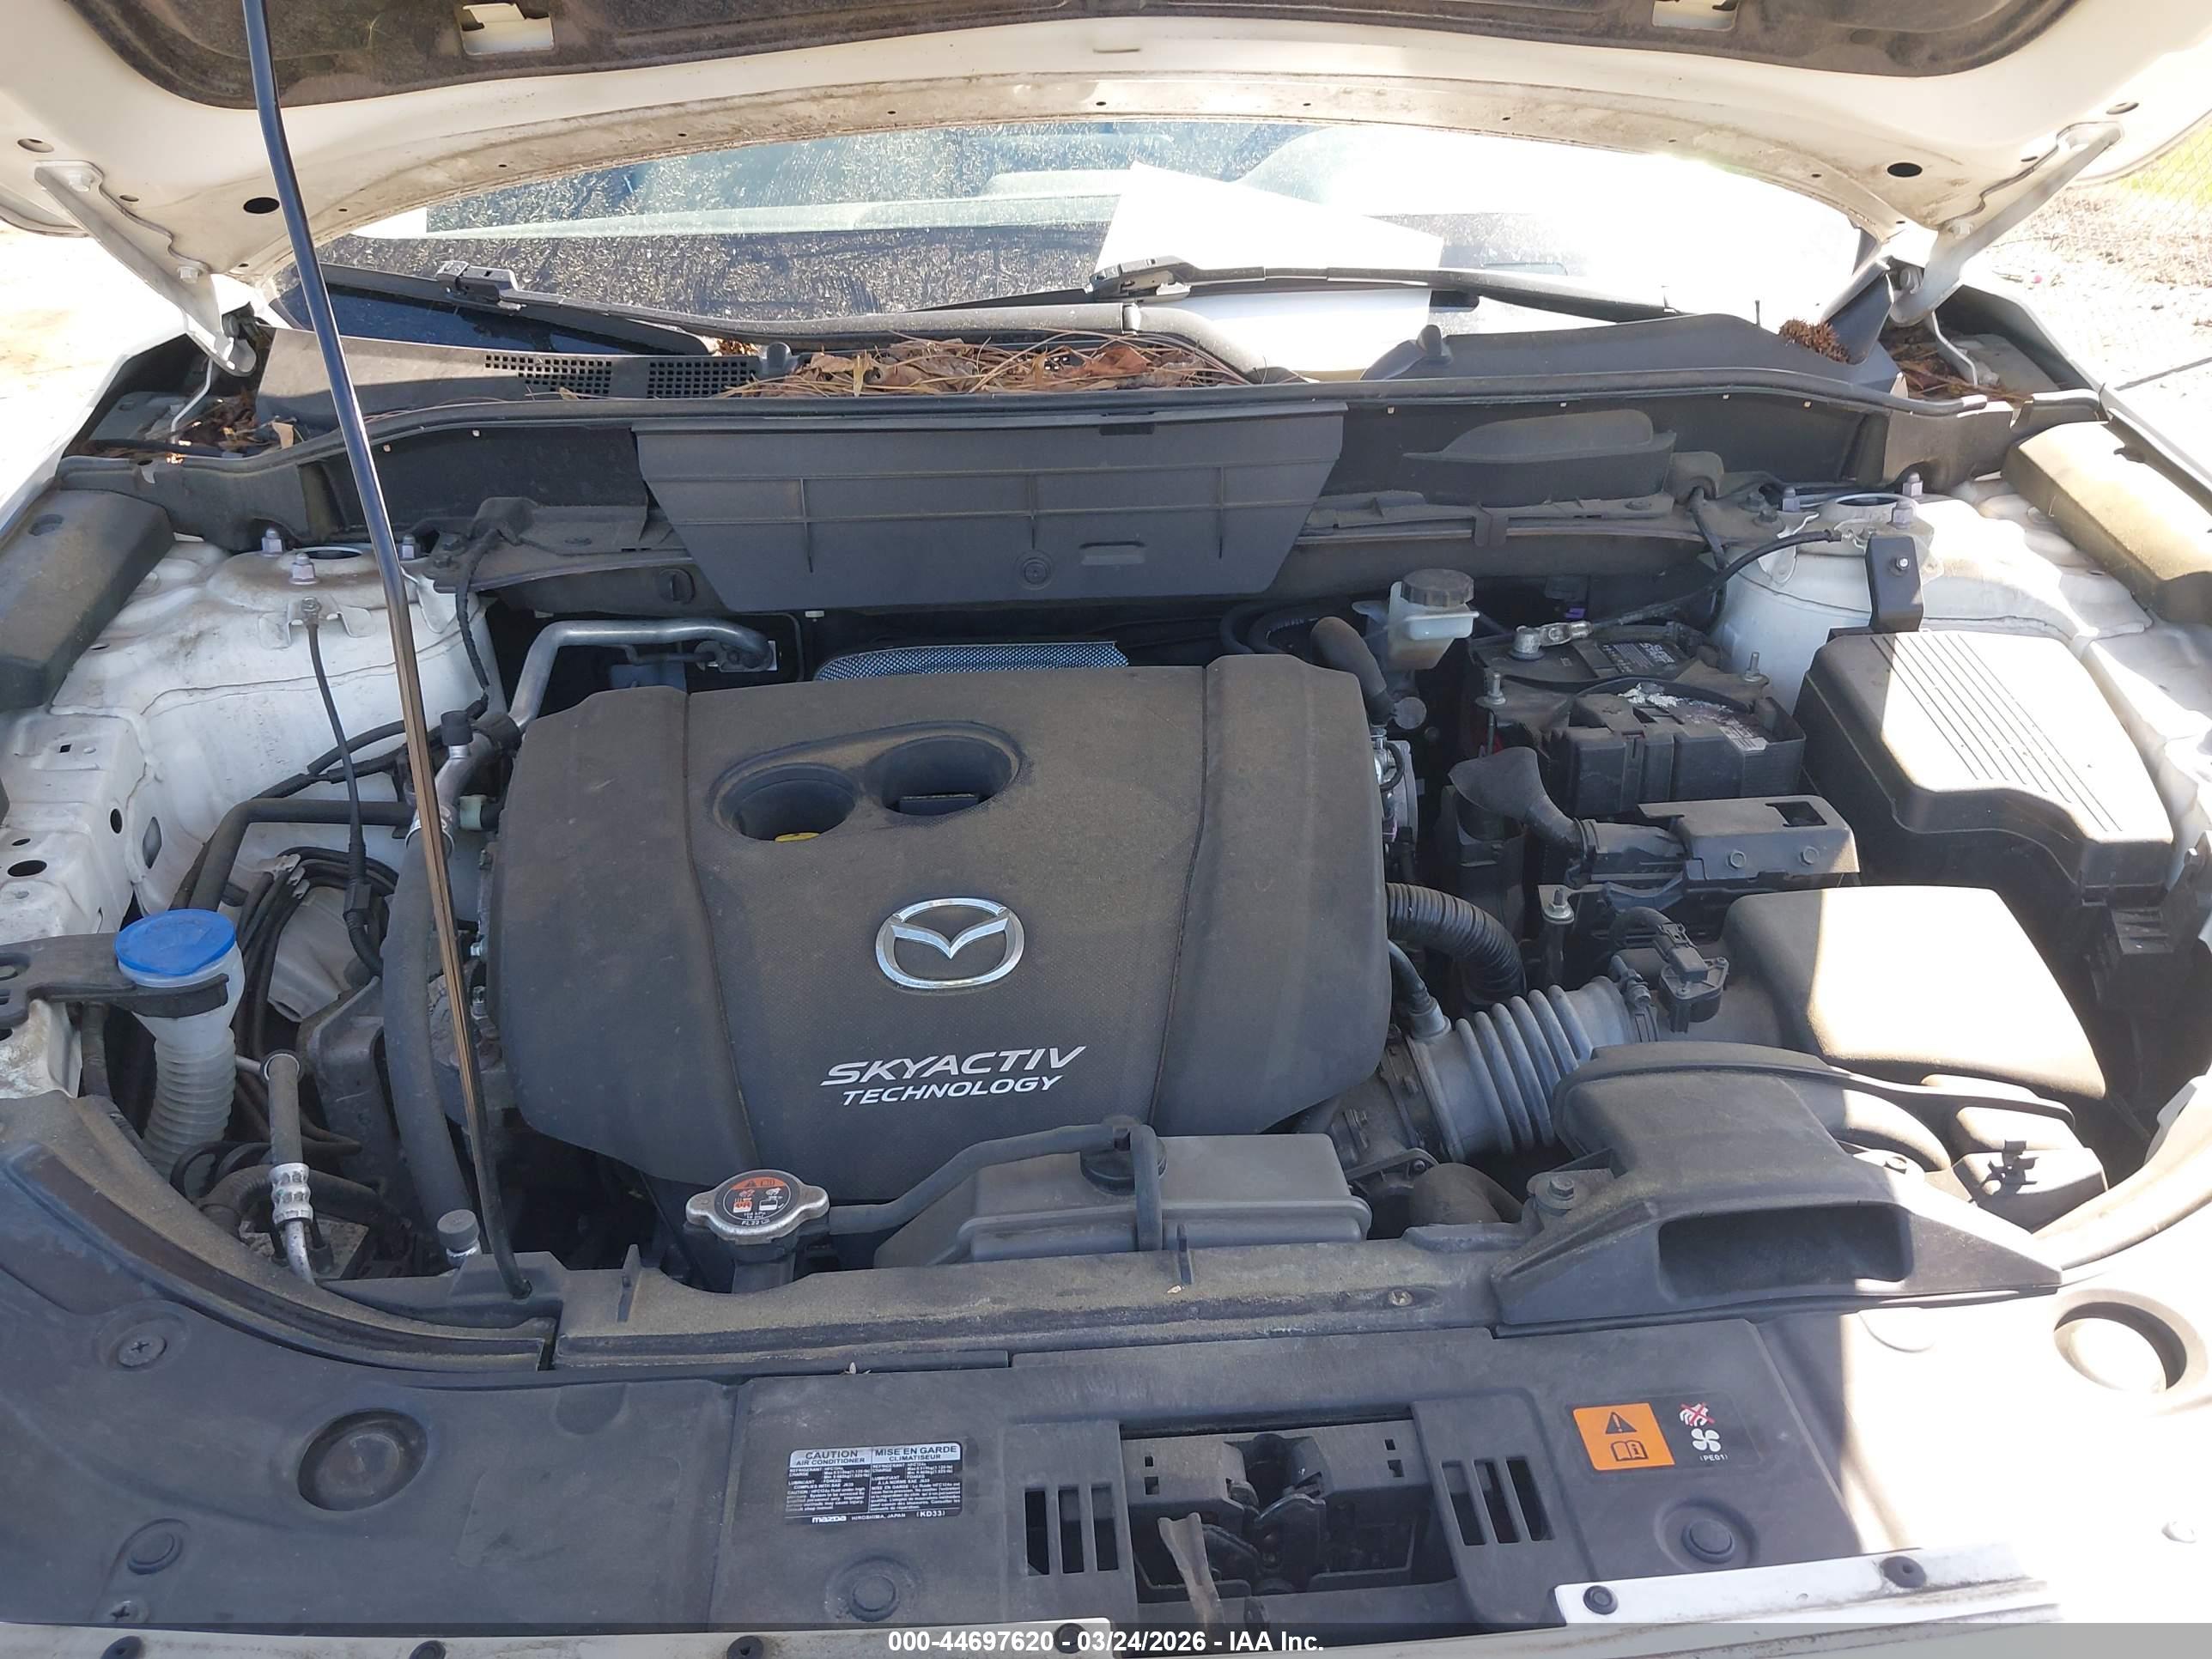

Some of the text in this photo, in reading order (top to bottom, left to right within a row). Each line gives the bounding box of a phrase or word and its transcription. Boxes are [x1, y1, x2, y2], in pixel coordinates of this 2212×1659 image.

[820, 1045, 1087, 1086] SKYACTIV
[842, 1075, 1063, 1106] TECHNOLOGY
[805, 1449, 858, 1460] CAUTION
[876, 1448, 901, 1456] MISE
[920, 1445, 957, 1454] GARDE
